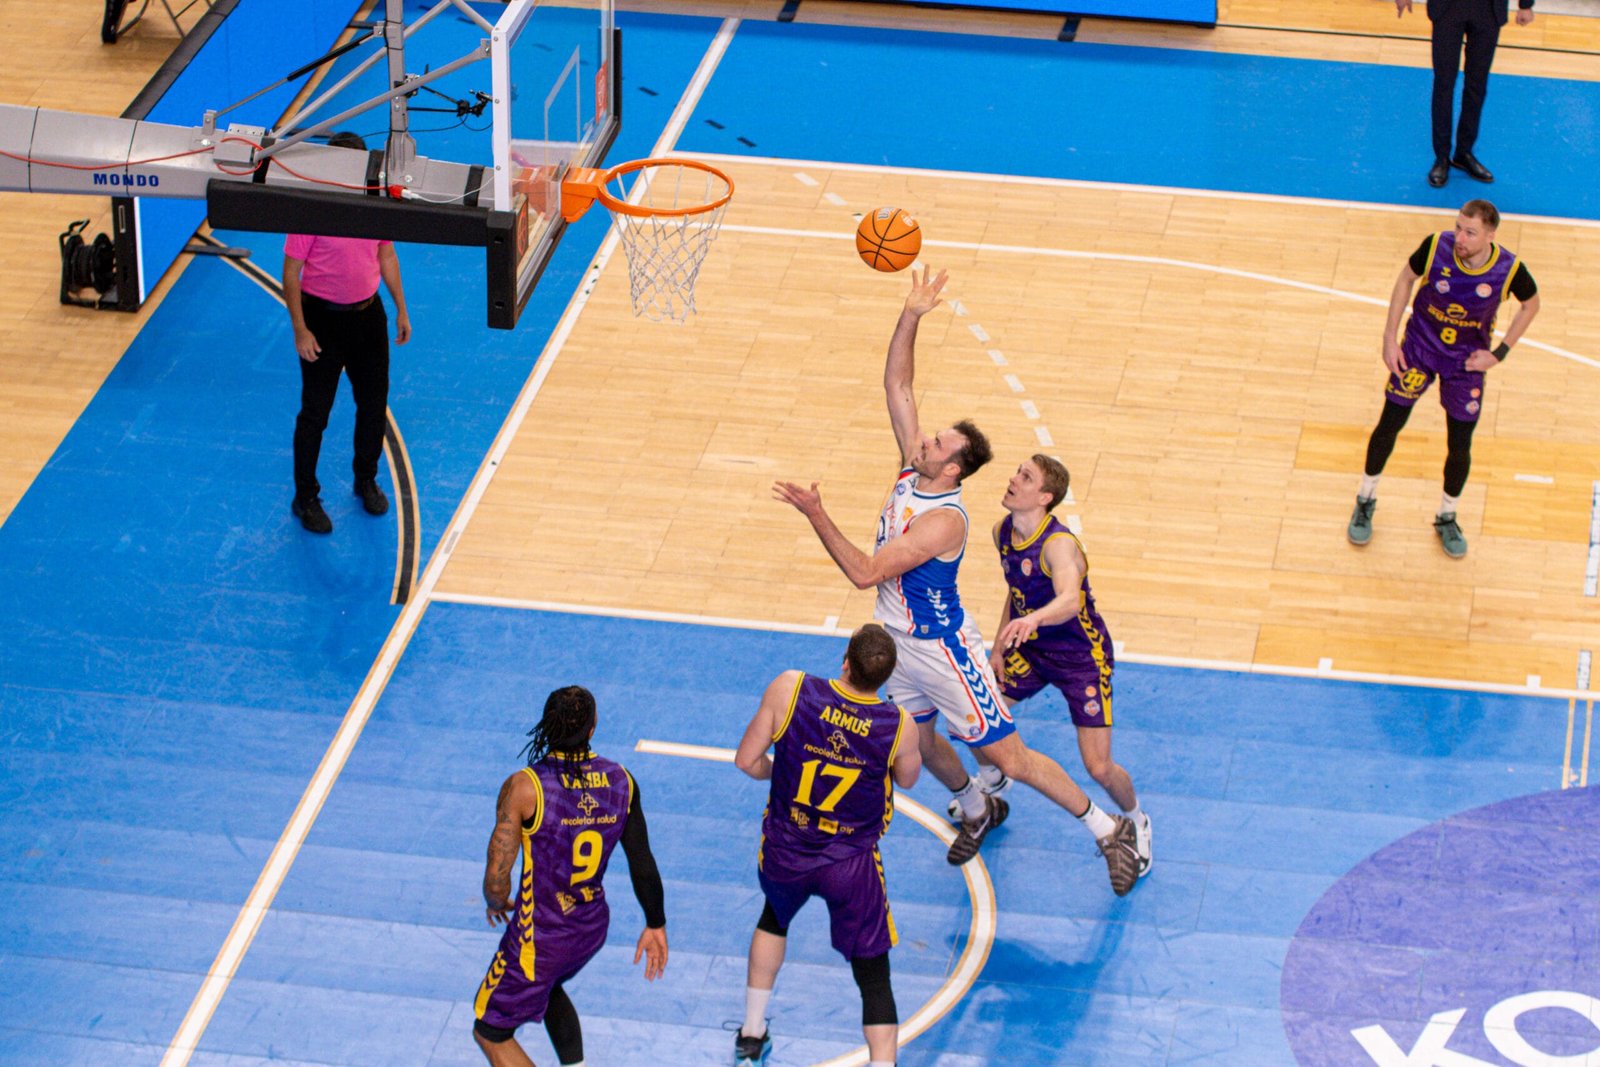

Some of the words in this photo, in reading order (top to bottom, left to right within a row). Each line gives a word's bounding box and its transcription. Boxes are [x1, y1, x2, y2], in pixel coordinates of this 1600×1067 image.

[93, 173, 159, 187] MONDO
[1427, 304, 1481, 329] agropal
[1440, 327, 1457, 345] 8
[819, 705, 873, 737] ARMUŠ
[803, 743, 842, 762] recoletas
[793, 759, 862, 812] 17
[561, 816, 595, 826] recoletas
[597, 815, 617, 825] salud
[570, 830, 603, 887] 9
